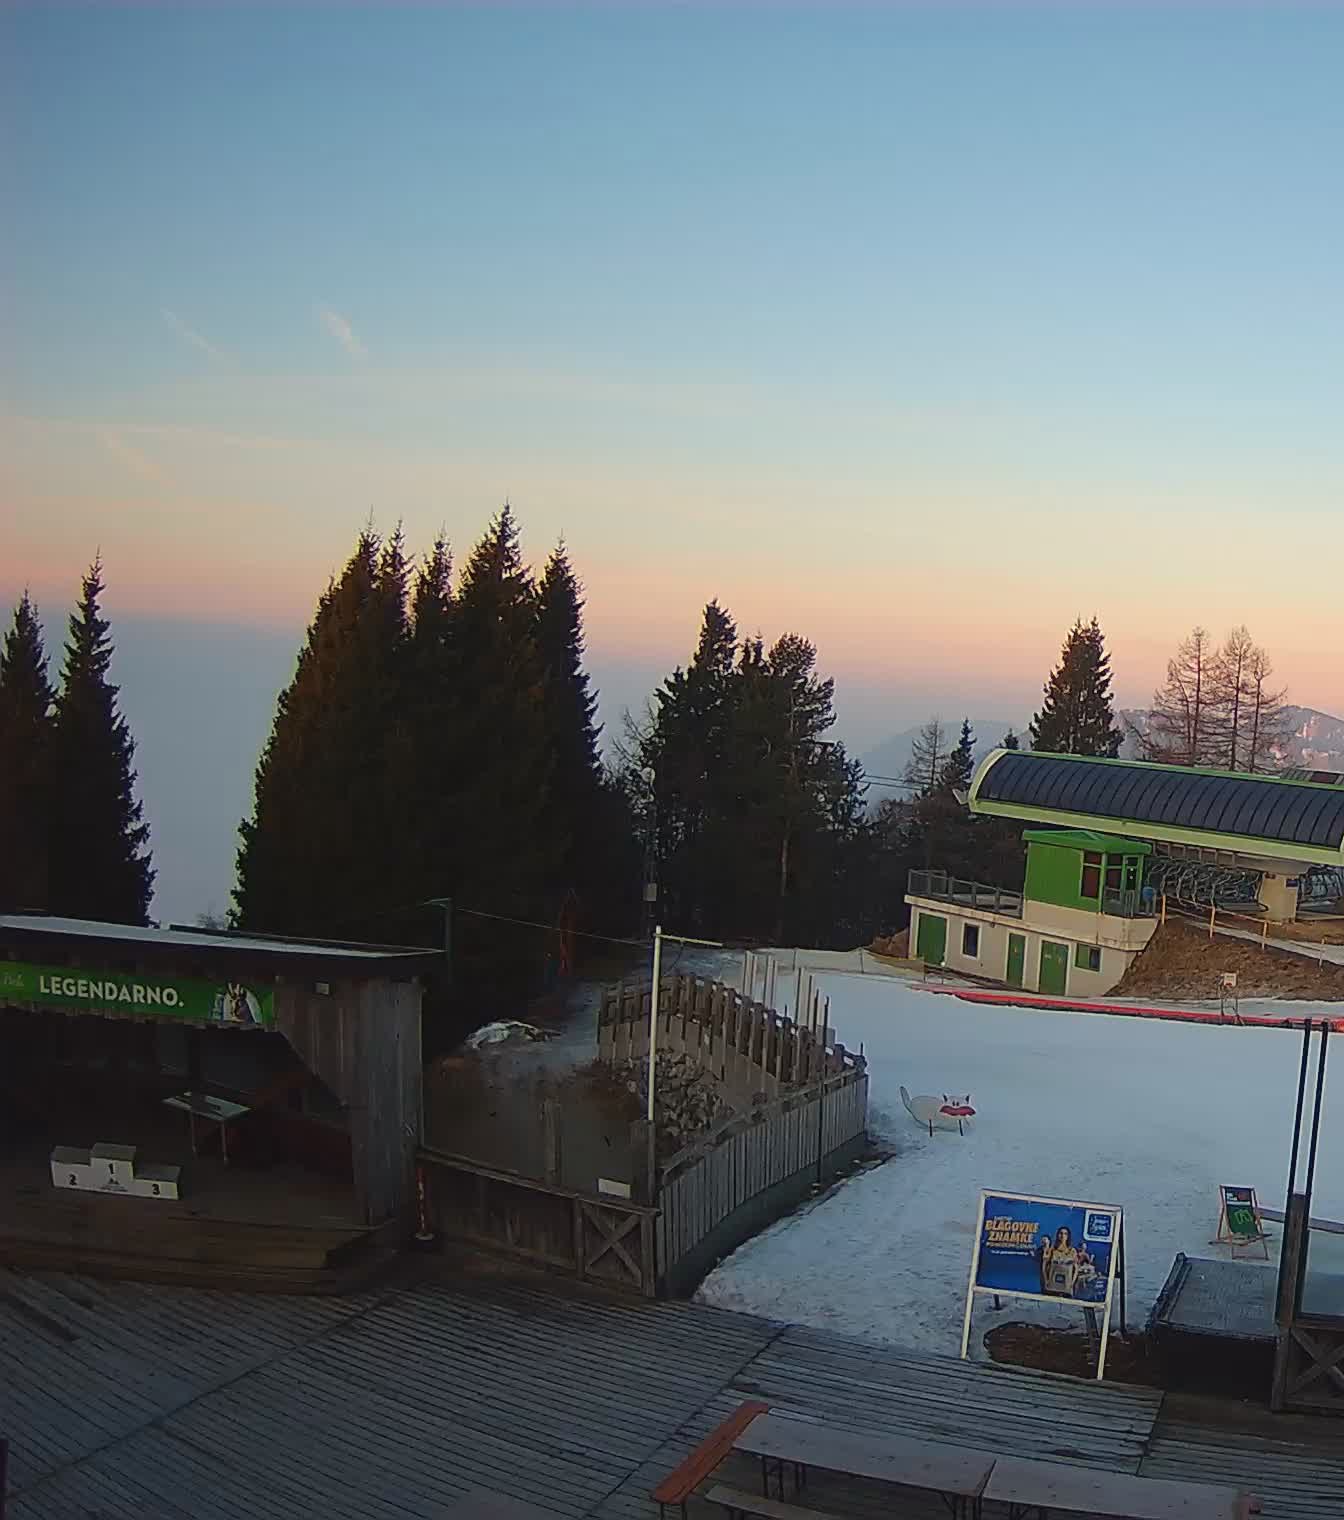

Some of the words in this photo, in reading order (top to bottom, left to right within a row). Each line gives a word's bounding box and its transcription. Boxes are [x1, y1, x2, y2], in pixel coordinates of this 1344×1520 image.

[40, 975, 184, 1007] LEGENDARNO.
[108, 1163, 114, 1174] 1
[69, 1174, 77, 1185] 2
[152, 1183, 160, 1195] 3
